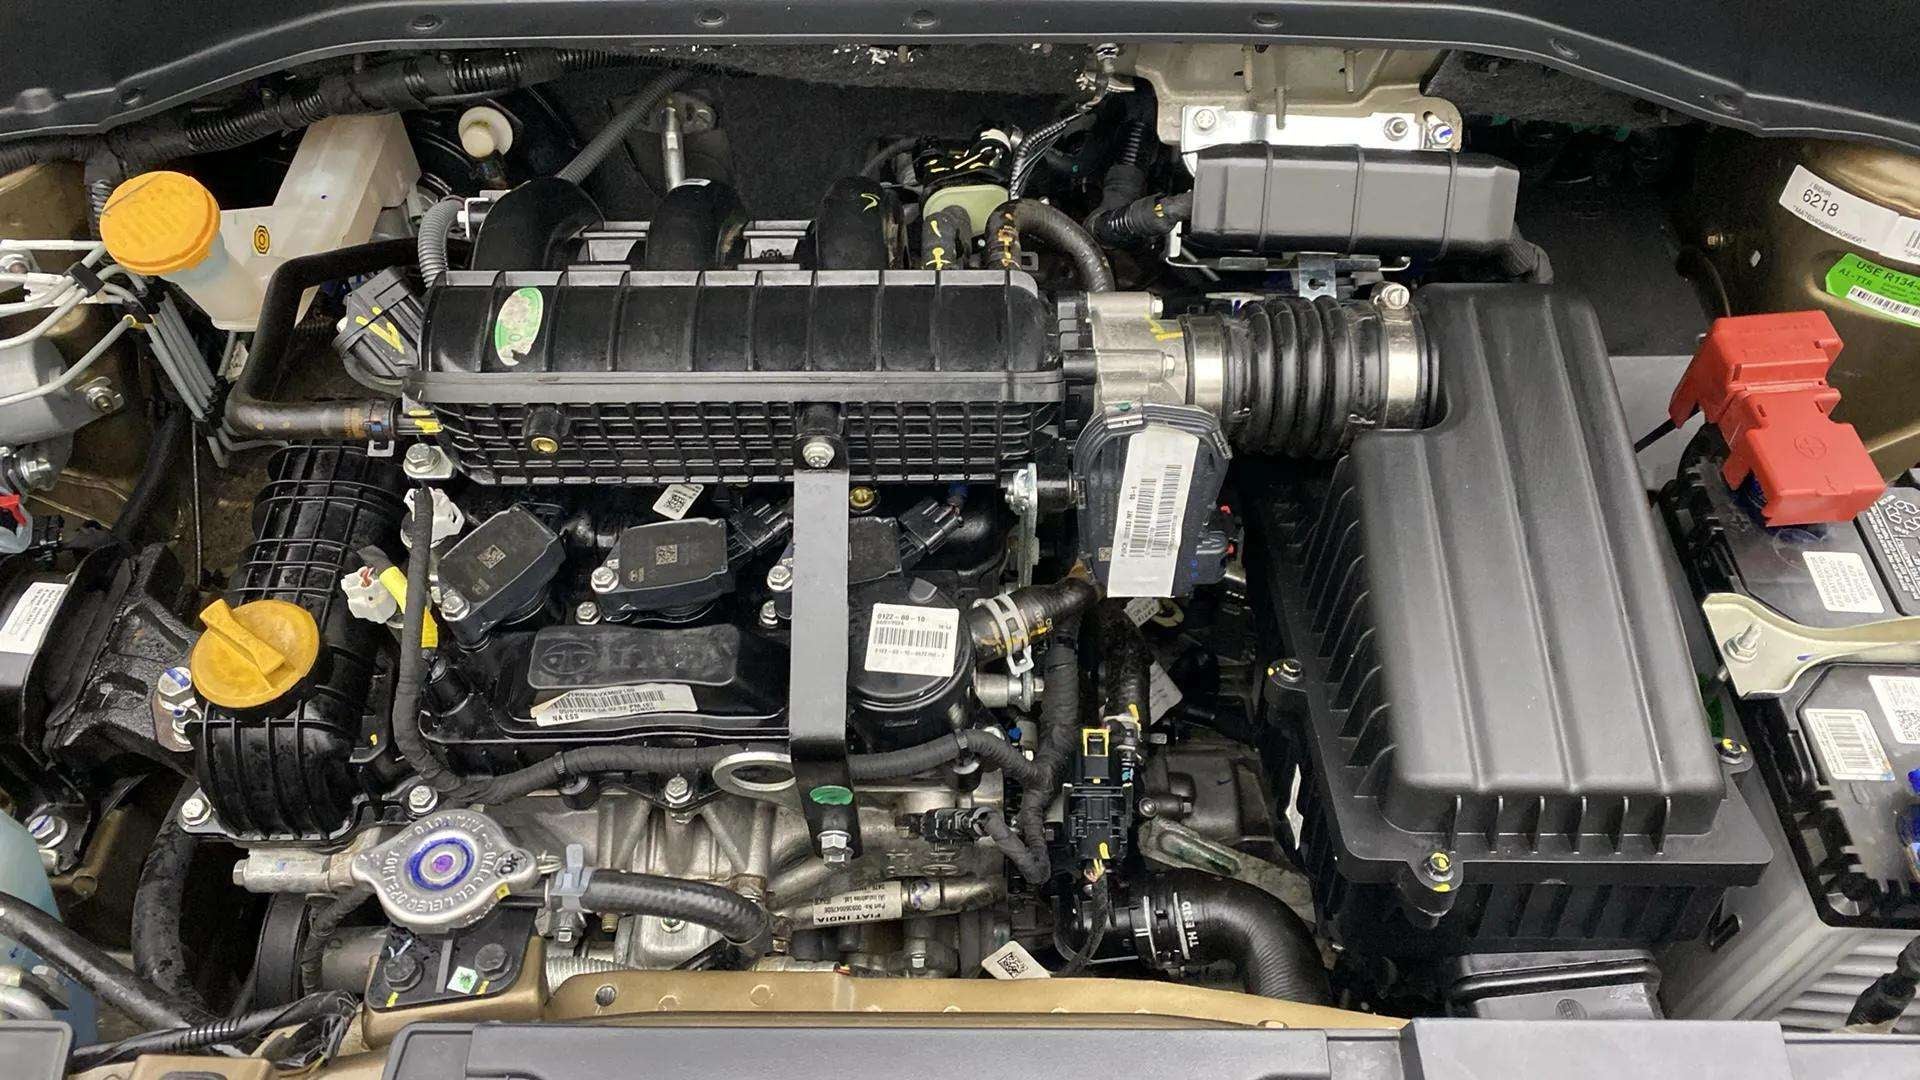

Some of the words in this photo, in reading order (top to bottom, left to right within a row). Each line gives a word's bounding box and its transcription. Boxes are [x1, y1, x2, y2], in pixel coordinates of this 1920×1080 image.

[1802, 188, 1839, 217] 6218
[1856, 260, 1883, 277] USE
[817, 914, 850, 923] INDIA
